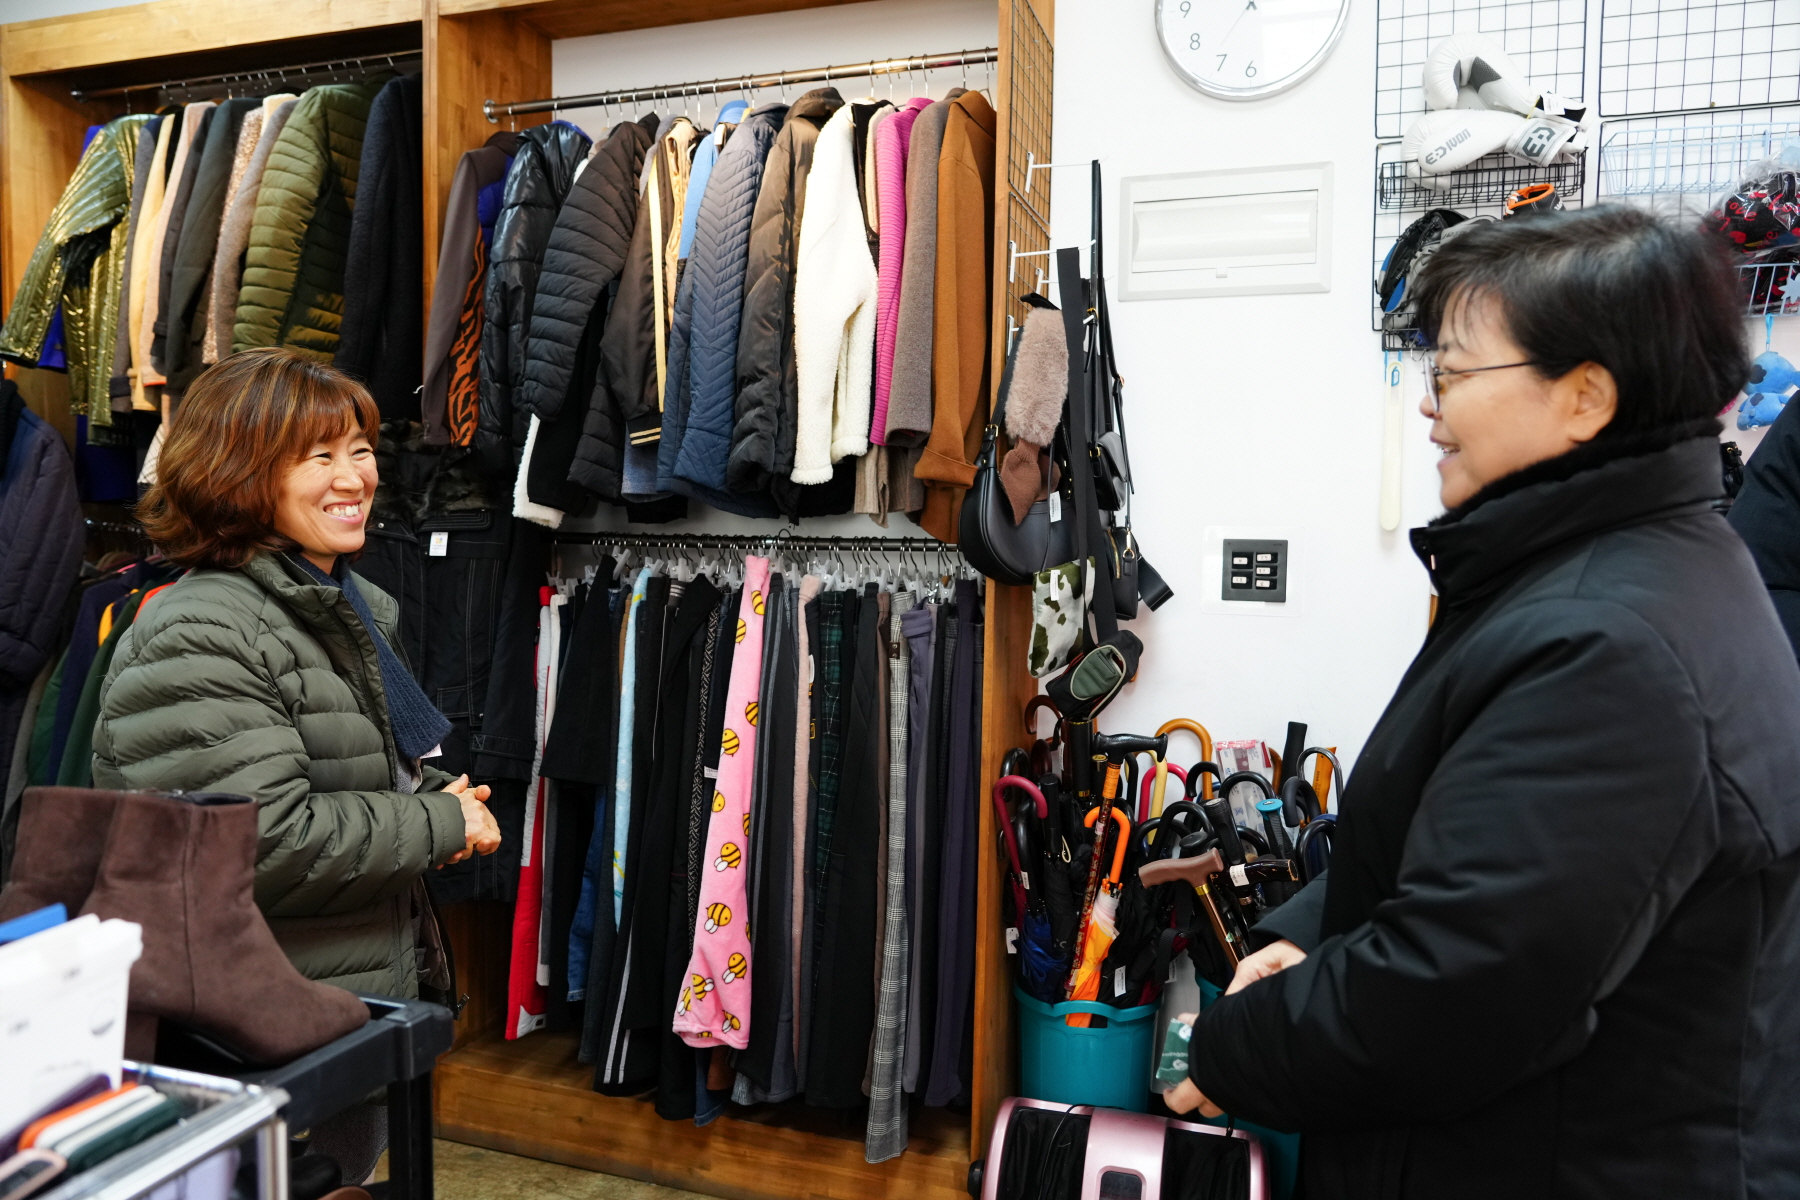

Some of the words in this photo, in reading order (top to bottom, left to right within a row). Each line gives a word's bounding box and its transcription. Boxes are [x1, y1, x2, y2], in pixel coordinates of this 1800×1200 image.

[1179, 1, 1191, 18] 9
[1189, 33, 1201, 50] 8
[1216, 54, 1228, 72] 7
[1245, 60, 1257, 77] 6
